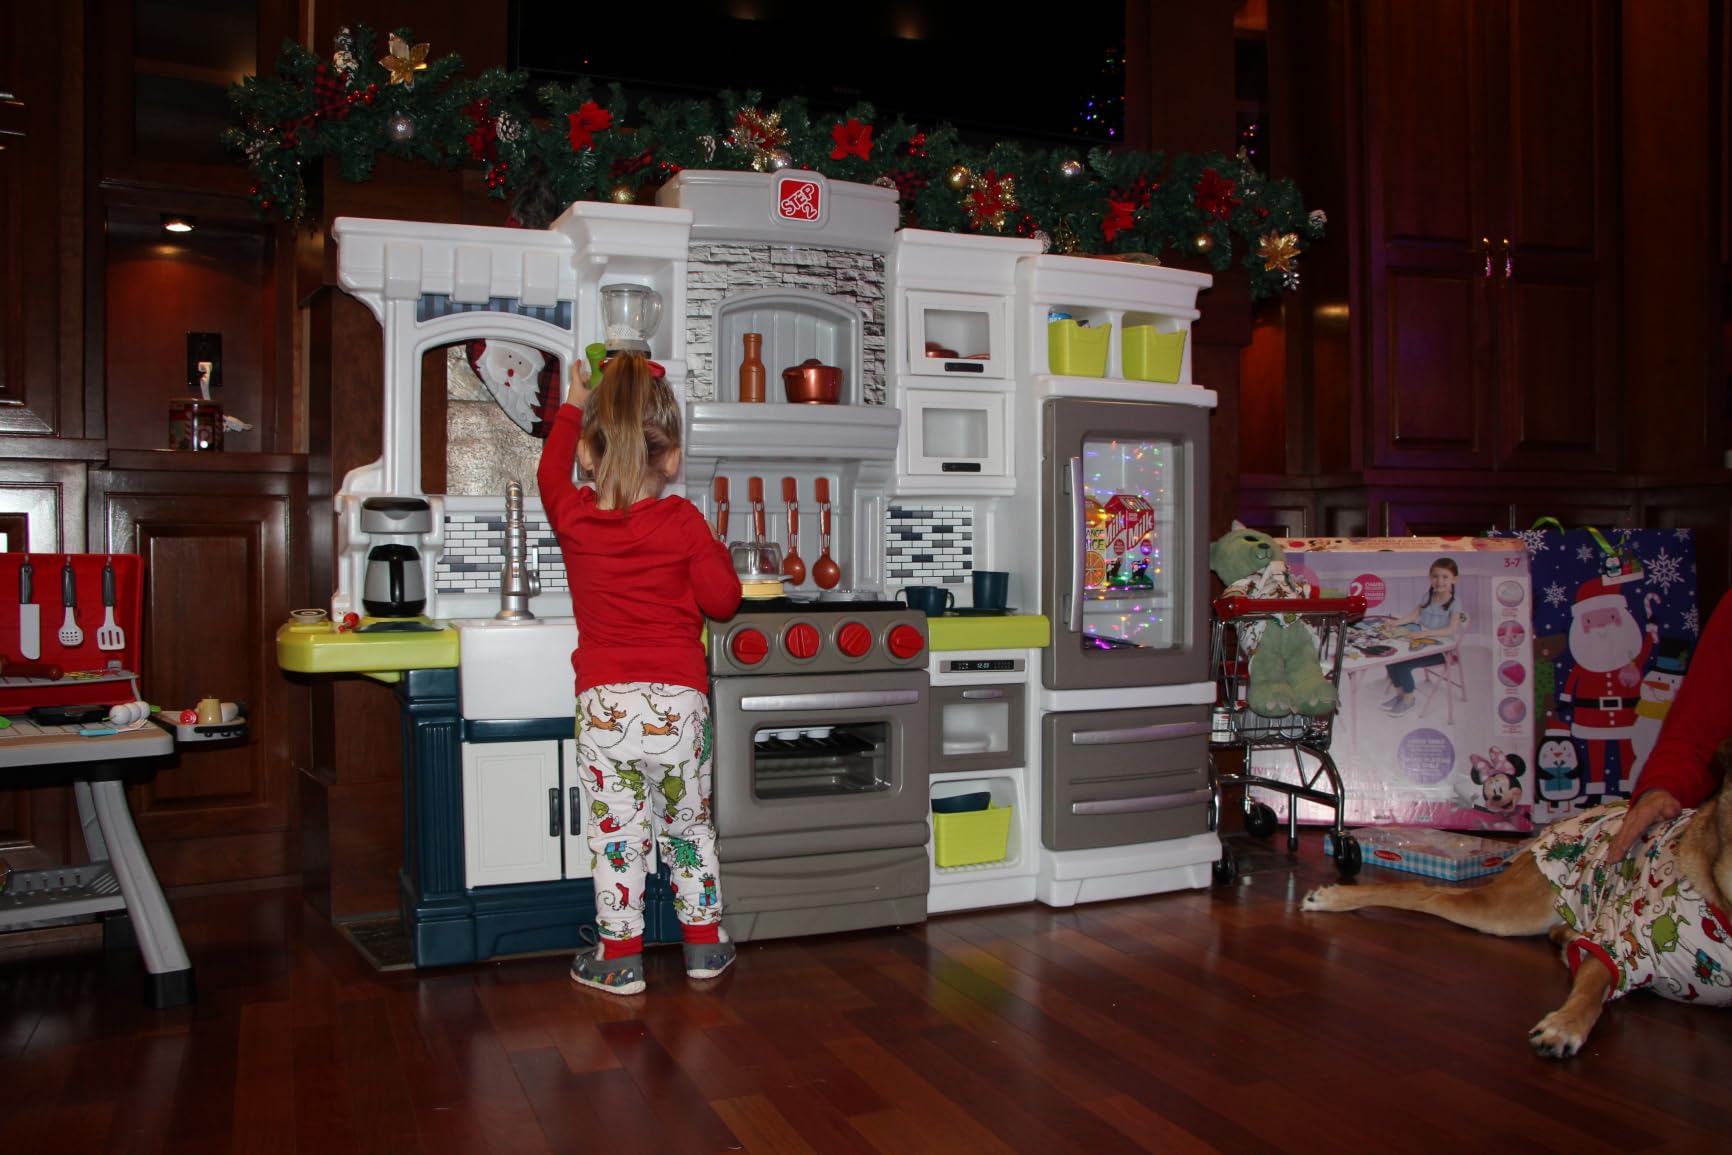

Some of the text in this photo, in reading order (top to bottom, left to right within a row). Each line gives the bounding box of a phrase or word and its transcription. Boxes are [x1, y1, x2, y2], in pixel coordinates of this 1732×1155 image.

[781, 184, 814, 215] STEP
[802, 203, 817, 218] 2
[1106, 511, 1125, 546] Milk
[1128, 511, 1153, 549] Milk
[1504, 558, 1521, 568] 3-7
[1349, 582, 1363, 597] 2
